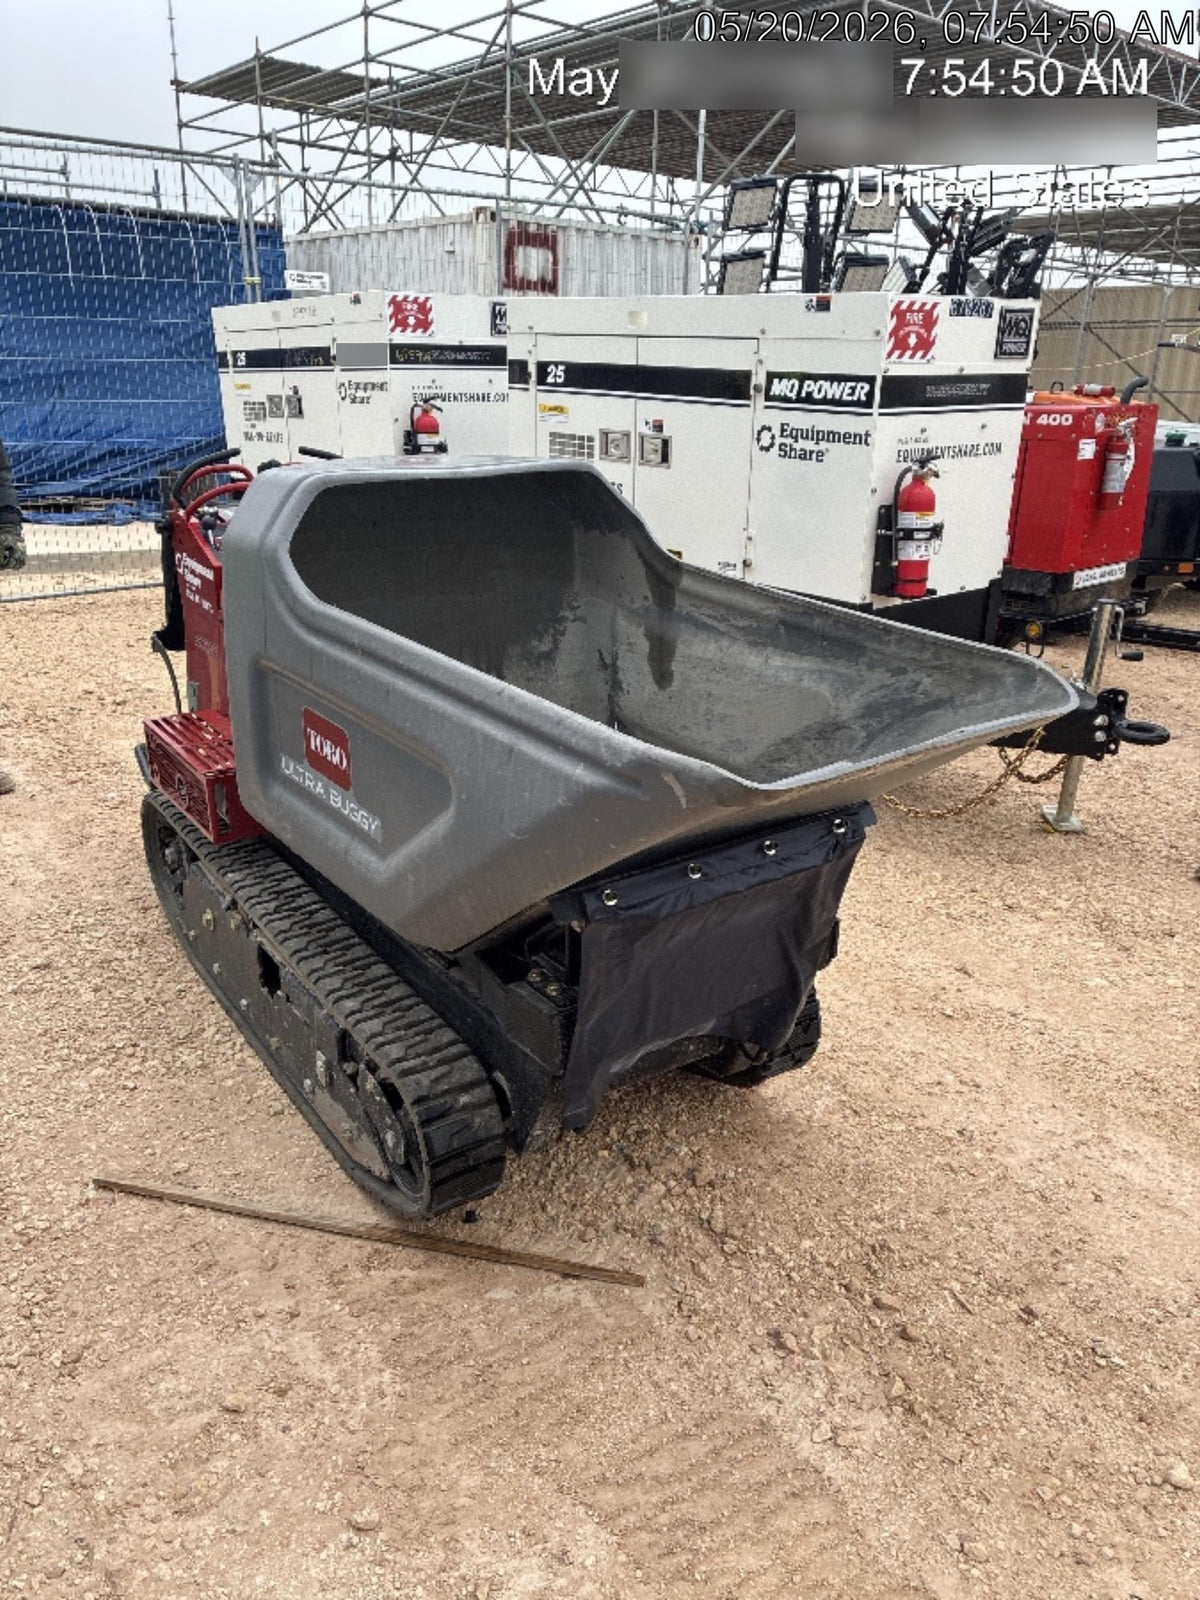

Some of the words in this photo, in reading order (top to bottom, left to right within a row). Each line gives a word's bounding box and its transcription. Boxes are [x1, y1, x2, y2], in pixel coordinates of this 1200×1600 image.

[546, 363, 566, 384] 25
[769, 378, 799, 401] MQ
[800, 380, 870, 401] POWER
[1036, 413, 1073, 426] 400
[778, 422, 872, 447] Equipment
[778, 442, 825, 463] Share
[306, 727, 348, 772] TORO
[281, 756, 326, 800] ULTRA
[329, 787, 379, 834] BUGGY
